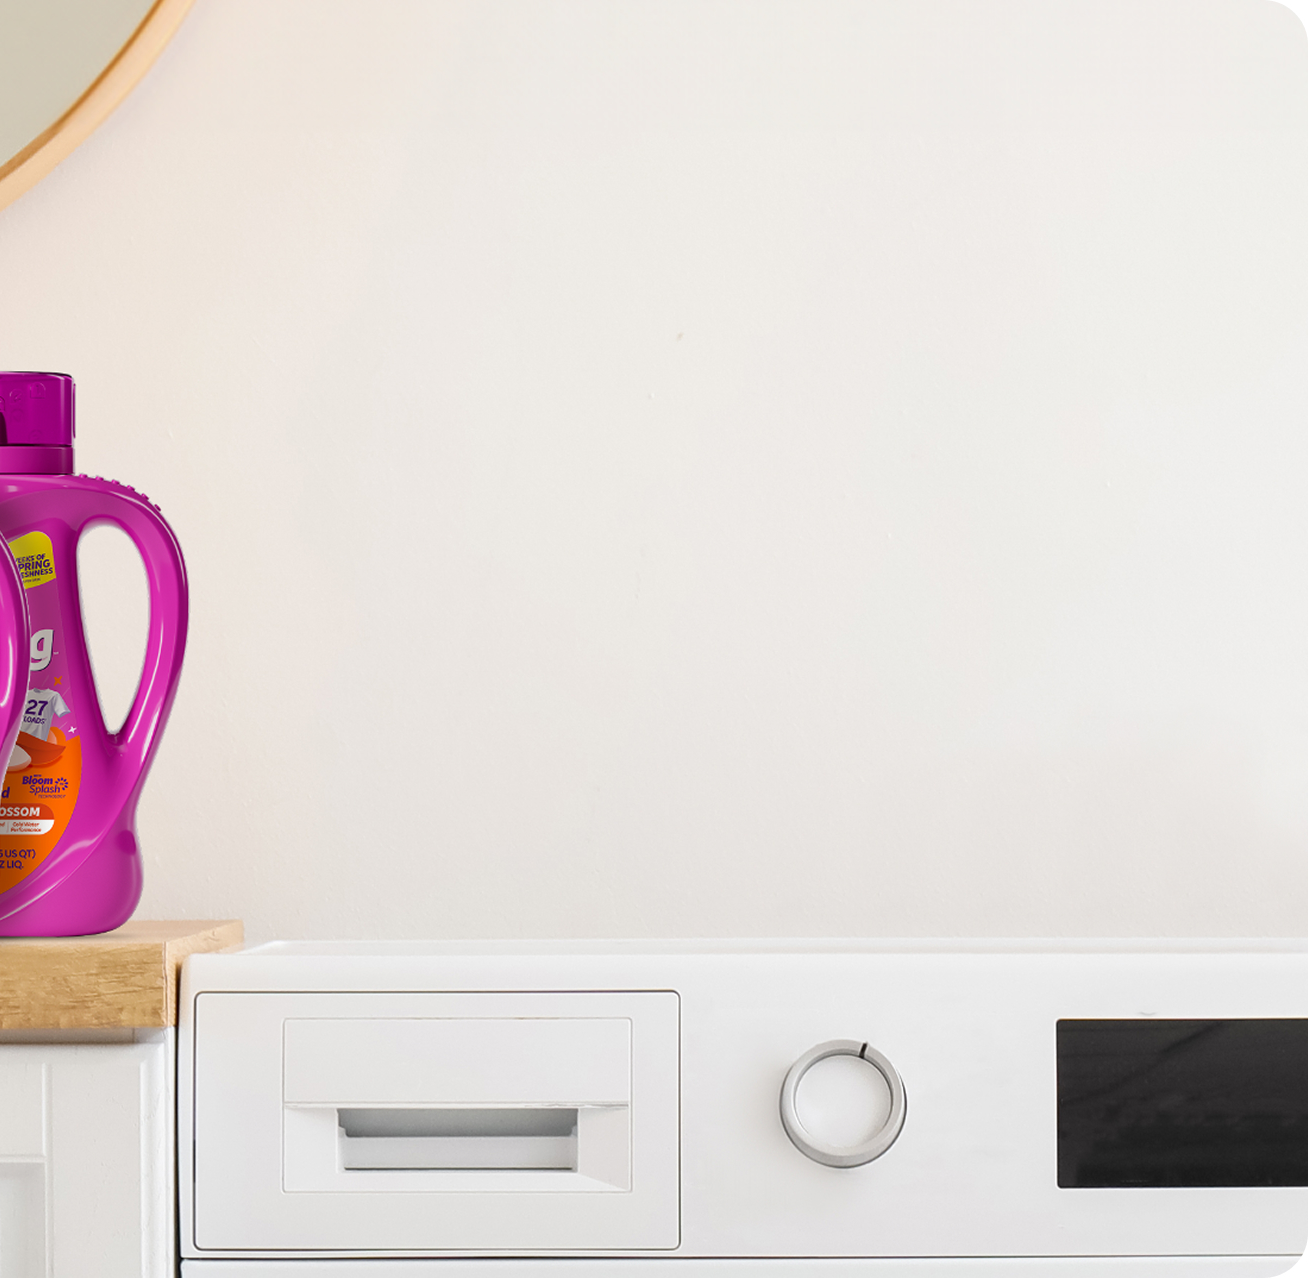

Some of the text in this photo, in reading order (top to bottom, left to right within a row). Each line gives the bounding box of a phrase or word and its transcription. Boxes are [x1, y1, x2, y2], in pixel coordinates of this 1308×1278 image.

[25, 699, 49, 716] 27
[22, 775, 53, 785] Bloom
[29, 785, 61, 796] Splash
[4, 849, 17, 858] US
[19, 849, 36, 859] QT)
[6, 860, 24, 870] LIQ.
